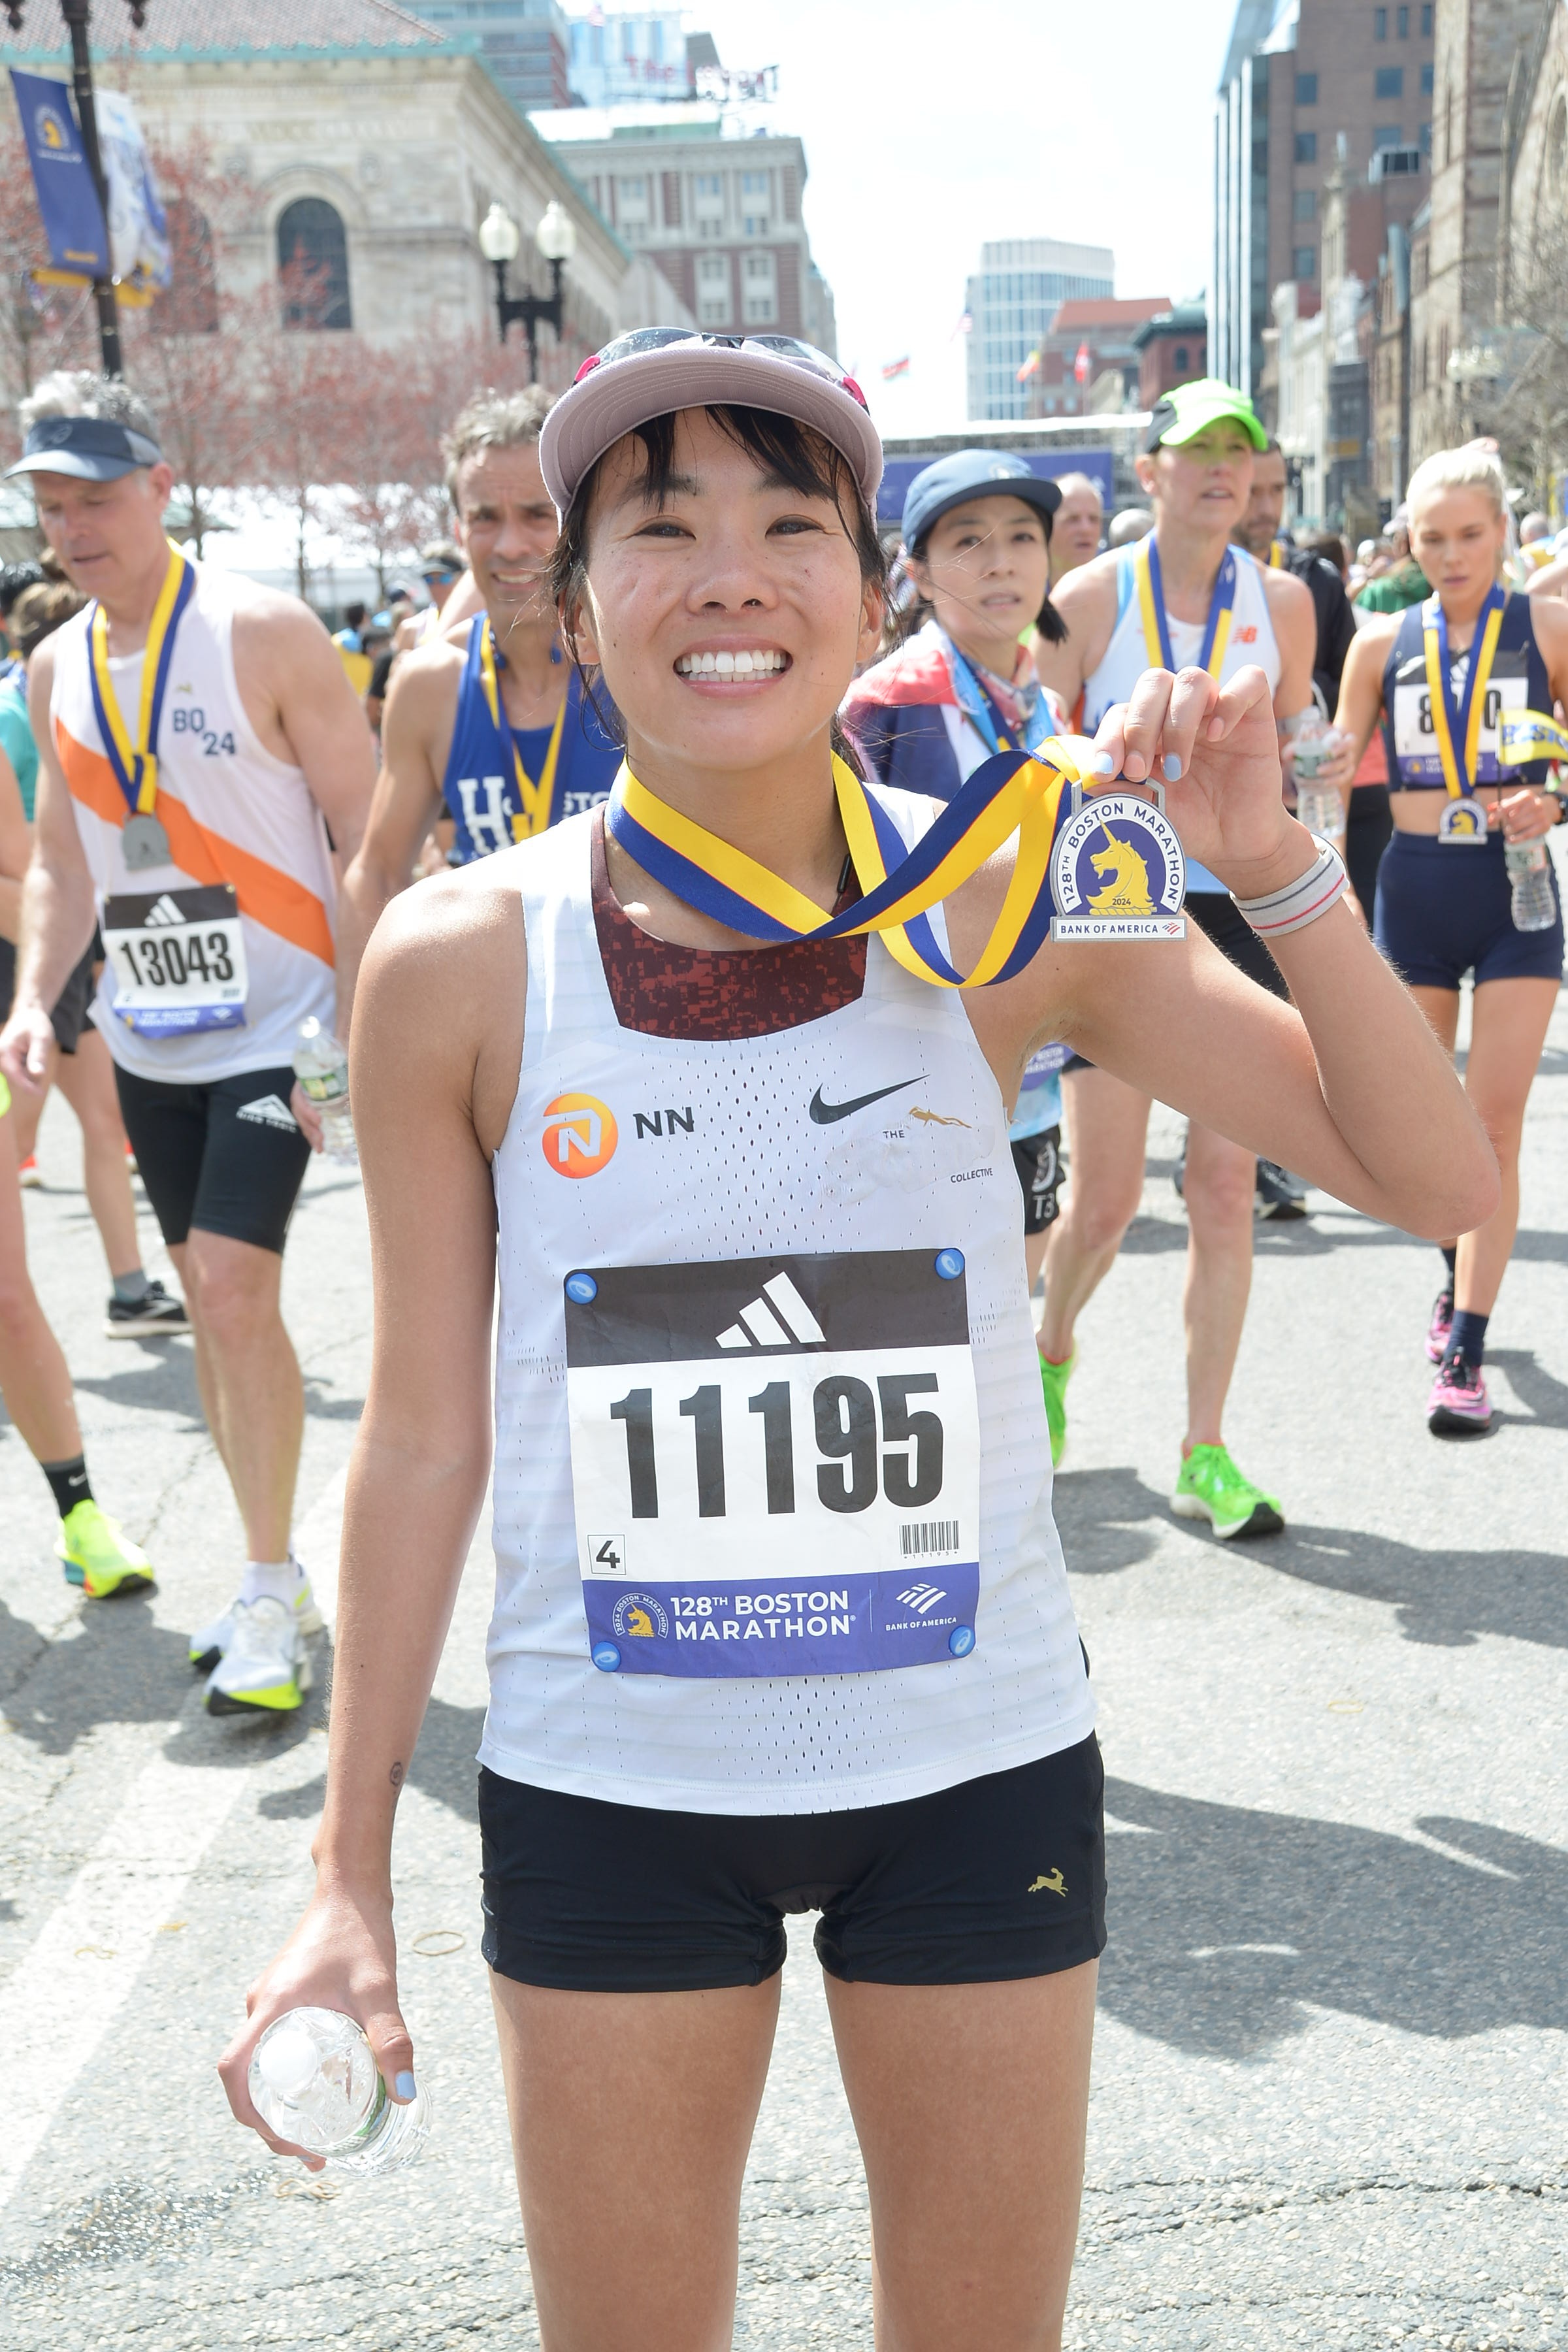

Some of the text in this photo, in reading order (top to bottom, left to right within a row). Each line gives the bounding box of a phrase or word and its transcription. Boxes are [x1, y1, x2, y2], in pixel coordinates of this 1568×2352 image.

[174, 709, 204, 732] BQ
[203, 732, 236, 755] 24
[1068, 802, 1124, 849] BOSTON
[1061, 855, 1076, 904] 128TH
[1061, 924, 1159, 934] BANK OF AMERICA
[120, 932, 234, 987] 13043
[632, 1107, 694, 1139] NN
[883, 1130, 906, 1139] THE
[950, 1168, 994, 1183] COLLECTIVE
[610, 1373, 943, 1518] 11195
[595, 1540, 621, 1569] 4
[614, 1595, 666, 1635] 2024 BOSTON MARATHON
[670, 1590, 849, 1616] 128TH BOSTON
[885, 1622, 908, 1631] BANK
[922, 1616, 957, 1627] AMERICA
